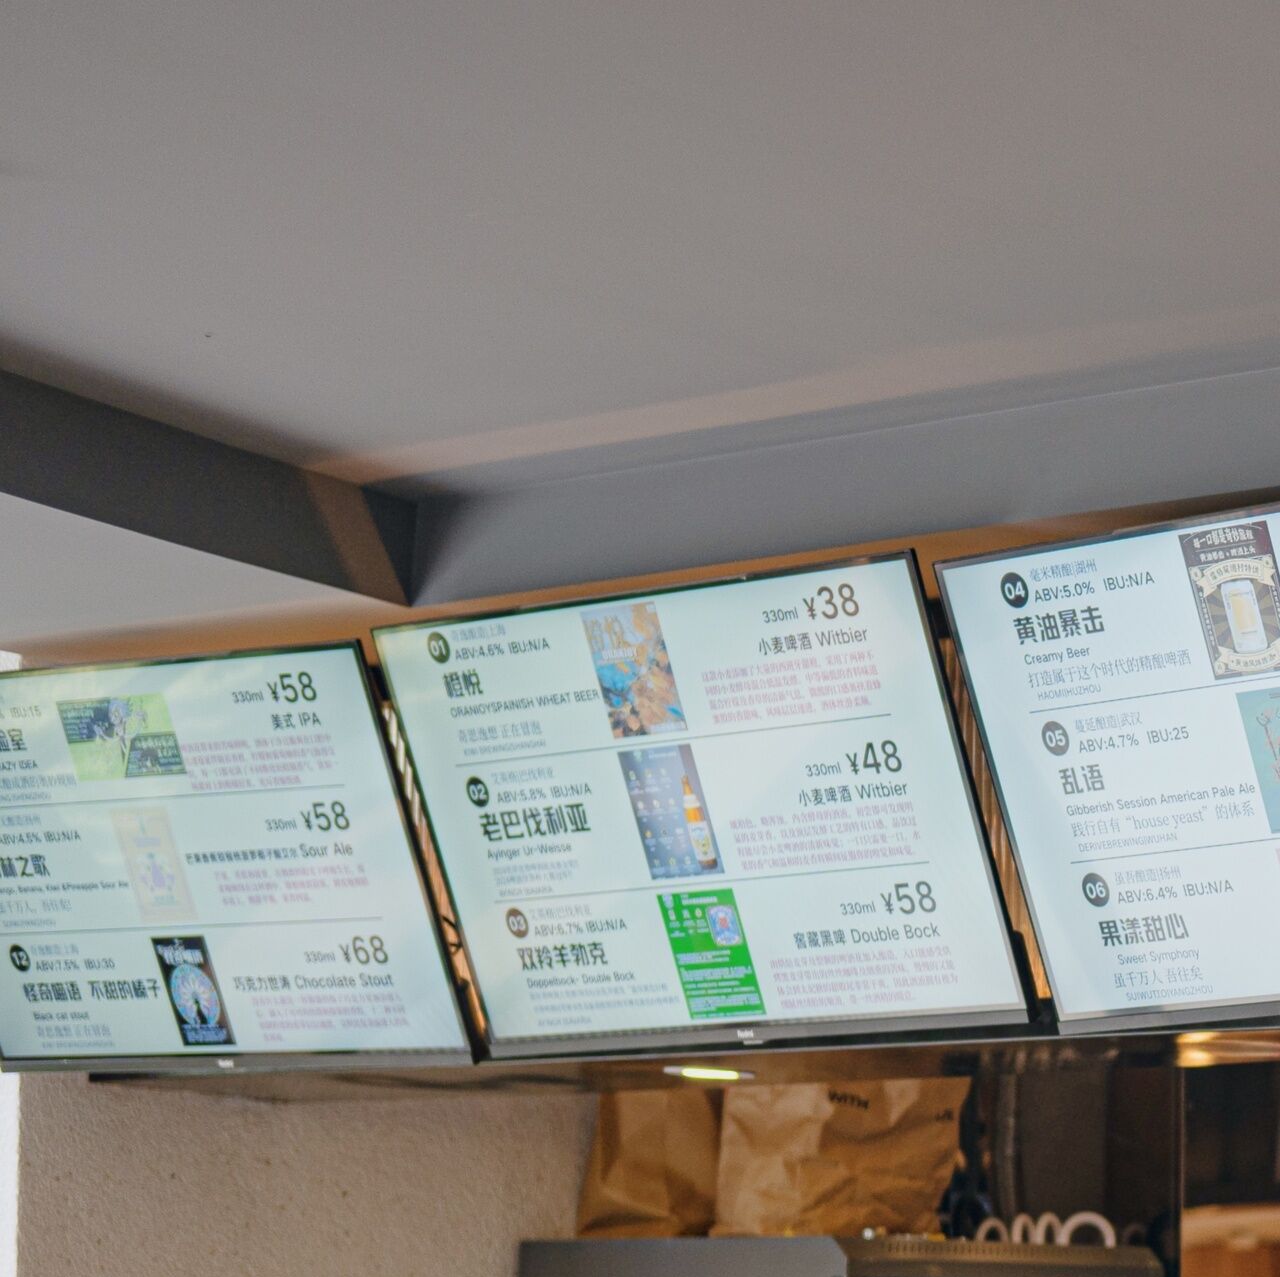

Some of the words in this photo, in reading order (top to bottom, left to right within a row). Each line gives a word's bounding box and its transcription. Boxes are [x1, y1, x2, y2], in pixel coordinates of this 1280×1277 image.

[1003, 582, 1027, 599] 04
[1034, 580, 1096, 602] ABV:5.0%
[1102, 571, 1155, 591] IBU:N/A
[761, 606, 799, 624] 330ml
[801, 582, 860, 621] ¥38
[1012, 604, 1105, 646] 黄油暴击
[507, 637, 551, 654] IBU:N/A
[758, 632, 813, 656] 小麦啤酒
[814, 626, 868, 647] Witbier
[1023, 650, 1064, 666] Creamy
[1065, 647, 1090, 659] Beer
[232, 691, 264, 704] 330ml
[266, 672, 318, 703] ¥58
[535, 692, 572, 707] WHEAT
[572, 688, 600, 702] BEER
[299, 713, 321, 728] IPA
[1043, 730, 1066, 747] 05
[1079, 732, 1140, 753] ABV:4.7%
[1146, 725, 1190, 744] IBU:25
[804, 761, 842, 777] 330ml
[845, 739, 903, 776] ¥48
[1058, 763, 1105, 796] 乱语
[796, 785, 852, 806] 小麦啤酒
[854, 781, 908, 800] Witbier
[1065, 800, 1114, 817] Gibberish
[1115, 796, 1157, 810] Session
[1160, 789, 1210, 805] American
[1211, 784, 1236, 797] Pale
[1239, 782, 1256, 794] Ale
[265, 818, 297, 831] 330ml
[300, 801, 350, 831] ¥58
[299, 843, 329, 859] Sour
[333, 842, 353, 856] Ale
[839, 900, 877, 915] 330ml
[879, 880, 937, 915] ¥58
[1084, 881, 1107, 898] 06
[1117, 885, 1178, 904] ABV:6.4%
[1182, 879, 1234, 897] IBU:N/A
[850, 925, 900, 944] Double
[903, 922, 941, 939] Bock
[1097, 913, 1189, 947] 果漾甜心
[304, 950, 336, 964] 330ml
[339, 935, 389, 965] ¥68
[1116, 951, 1148, 965] Sweet
[1149, 948, 1201, 964] Symphony
[294, 975, 357, 990] Chocolate
[360, 973, 394, 987] Stout
